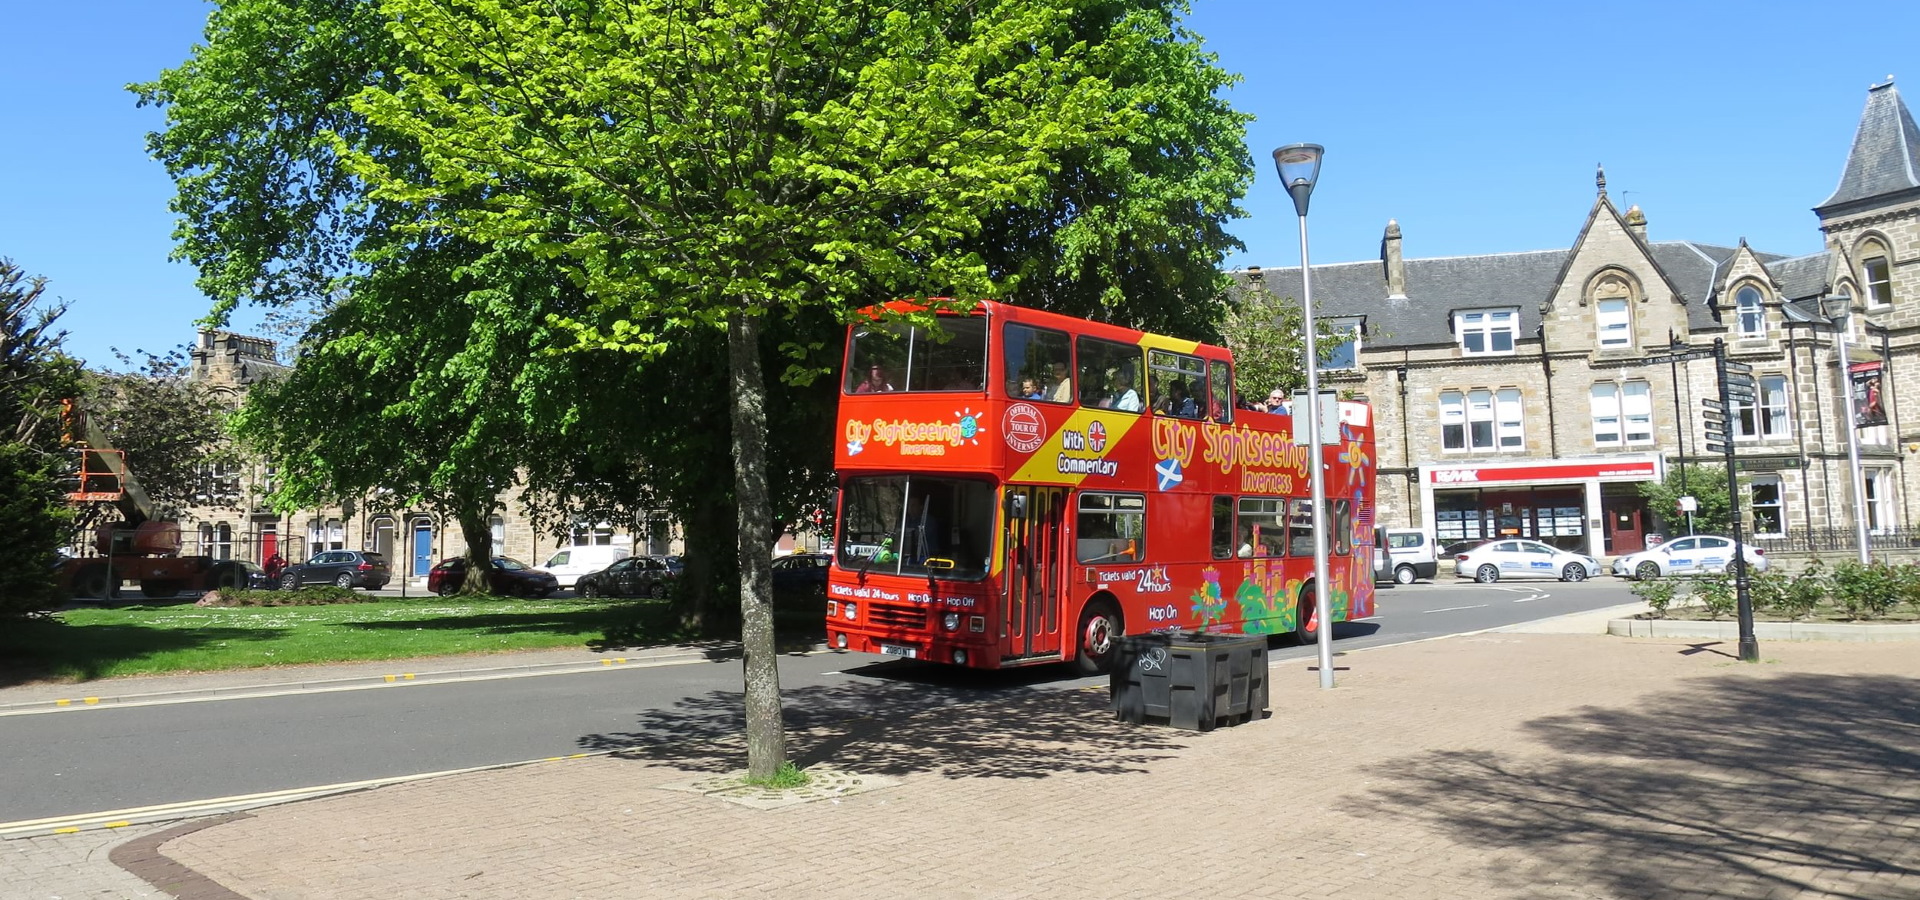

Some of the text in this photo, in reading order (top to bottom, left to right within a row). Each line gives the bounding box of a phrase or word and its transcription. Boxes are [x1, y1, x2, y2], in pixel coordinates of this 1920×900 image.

[1009, 405, 1038, 419] OFFICIAL
[846, 418, 961, 447] City Sightseeing
[1011, 423, 1038, 433] TOUR OF
[900, 442, 945, 455] Inverness
[1006, 434, 1042, 450] INVERNESS
[1063, 430, 1084, 451] With
[1152, 415, 1309, 478] City Sightseeing
[1057, 453, 1118, 477] Commentary
[1242, 464, 1292, 494] Inverness
[1099, 569, 1171, 592] Tickets valid 24 hours
[831, 585, 900, 601] Tickets valid 24 hours
[908, 593, 922, 603] Hop
[923, 594, 933, 603] On
[947, 598, 961, 607] Hop
[962, 597, 975, 607] Off
[1149, 604, 1177, 621] Hop On
